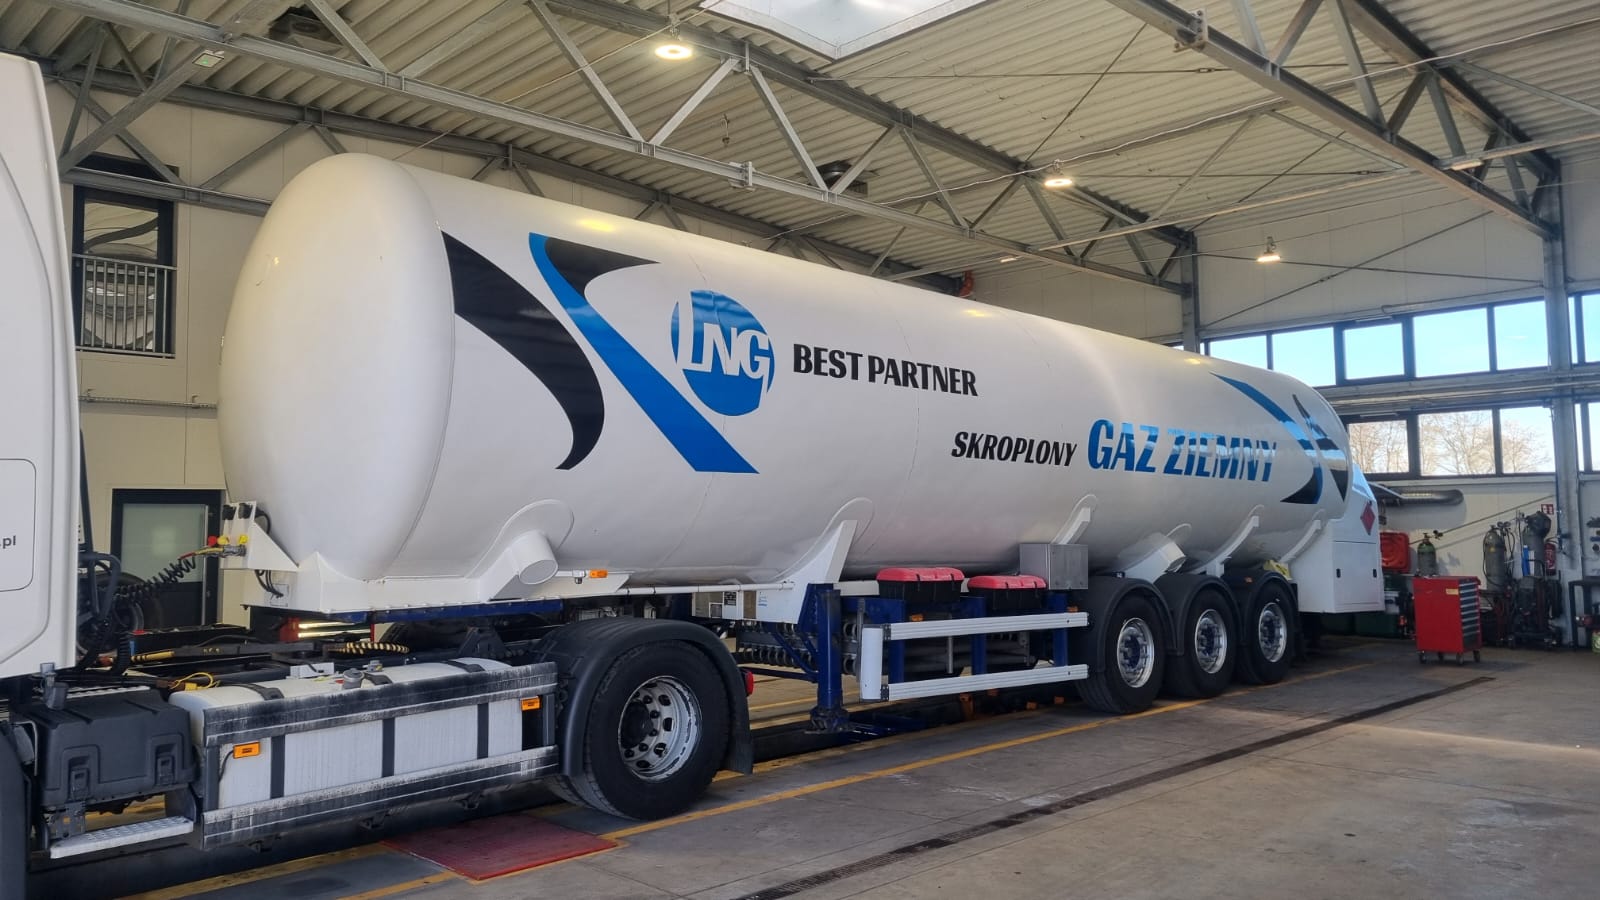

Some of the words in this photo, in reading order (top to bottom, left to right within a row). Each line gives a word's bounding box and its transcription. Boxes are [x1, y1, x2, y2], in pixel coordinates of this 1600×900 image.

[677, 290, 772, 409] LNG
[793, 343, 863, 381] BEST
[868, 355, 978, 397] PARTNER
[951, 431, 1077, 467] SKROPLONY
[1087, 419, 1160, 474] GAZ
[1162, 428, 1277, 482] ZIEMNY
